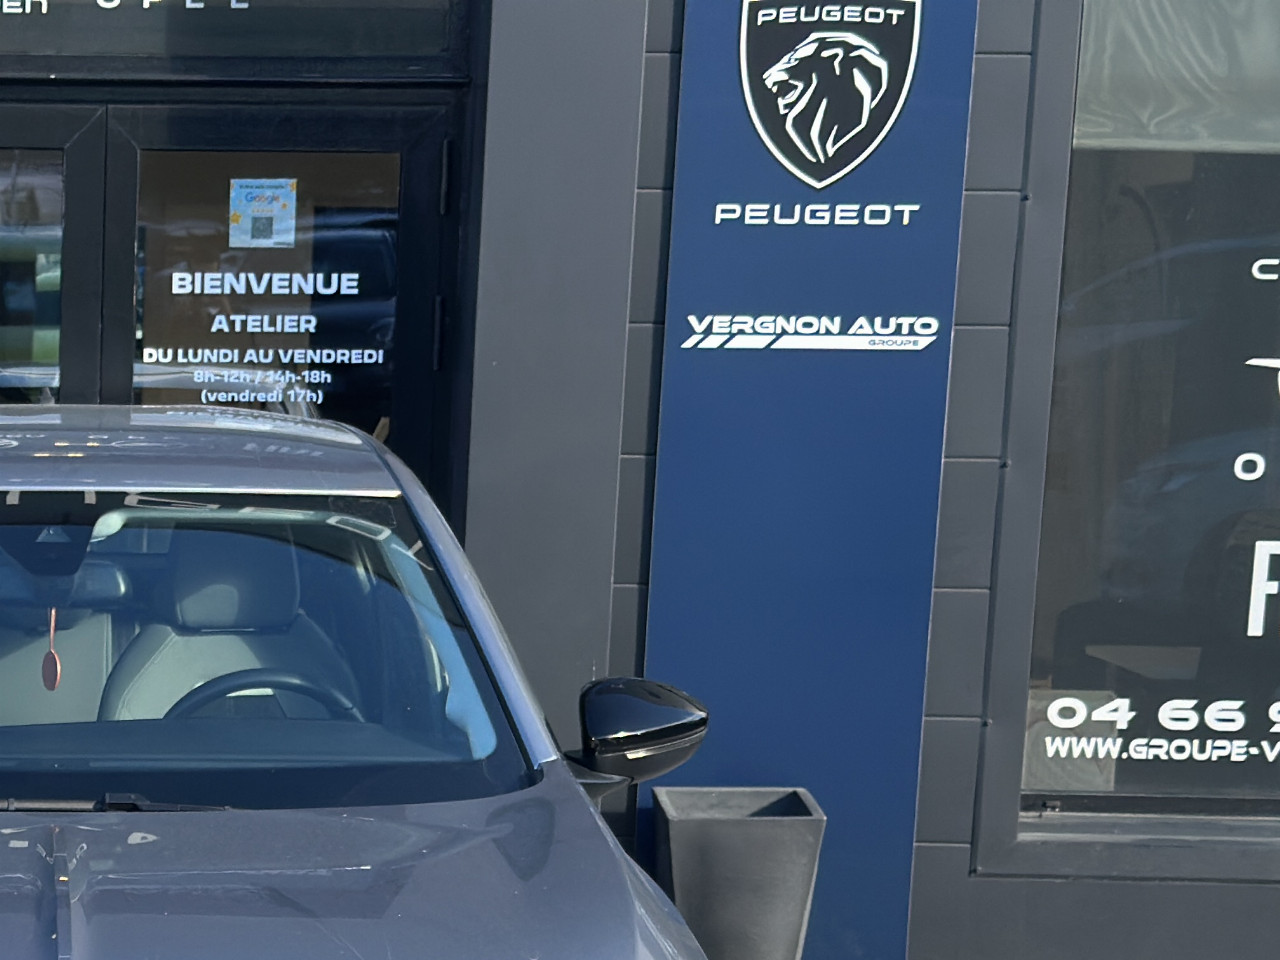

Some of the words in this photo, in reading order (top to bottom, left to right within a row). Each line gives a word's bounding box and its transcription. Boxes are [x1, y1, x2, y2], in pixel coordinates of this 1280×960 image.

[757, 5, 905, 26] PEUGEOT
[714, 203, 921, 226] PEUGEOT
[171, 271, 360, 295] BIENVENUE
[210, 314, 318, 333] ATELIER
[687, 314, 841, 334] VERGNON
[846, 315, 940, 335] AUTO
[868, 338, 920, 347] GROUPE
[142, 348, 173, 364] DU
[177, 348, 239, 364] LUNDI
[243, 349, 273, 364] AU
[278, 349, 384, 364] VENDREDI
[193, 369, 251, 384] 8h-12h
[267, 369, 332, 384] 14h-18h
[200, 389, 283, 404] (vendredi
[287, 389, 324, 404] 17h)
[1046, 697, 1137, 729] 04
[1157, 699, 1246, 732] 66
